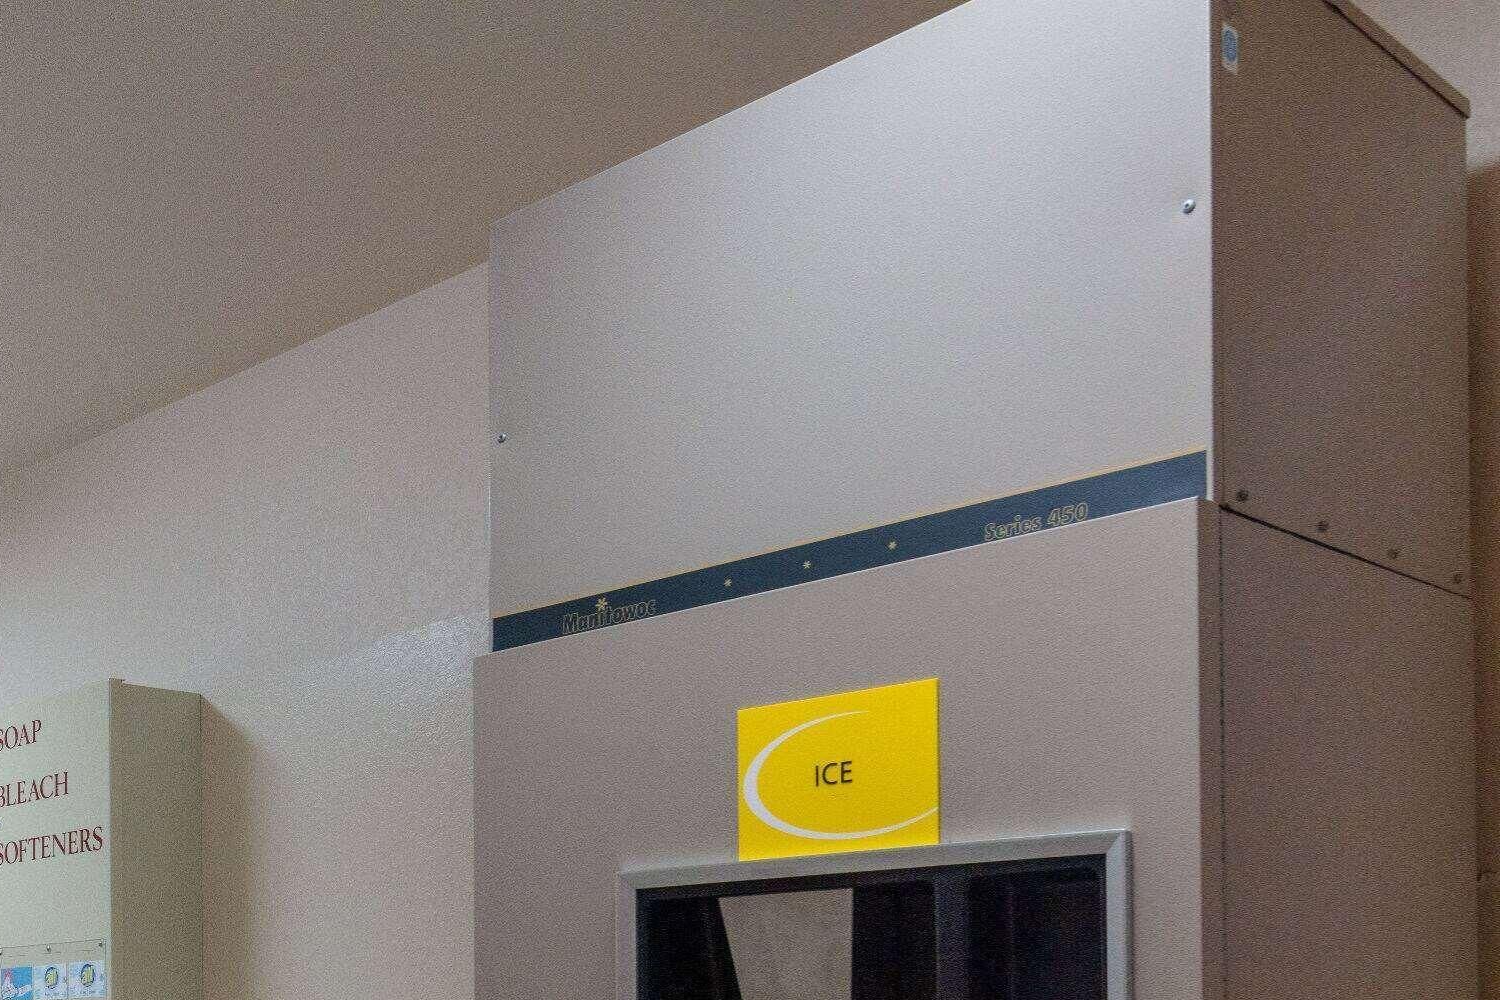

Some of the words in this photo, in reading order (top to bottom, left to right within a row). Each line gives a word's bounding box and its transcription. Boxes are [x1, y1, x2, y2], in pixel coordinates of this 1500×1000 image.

[985, 515, 1041, 541] Series
[1047, 502, 1089, 526] 450
[562, 600, 657, 634] Manitowoc
[815, 760, 853, 787] ICE
